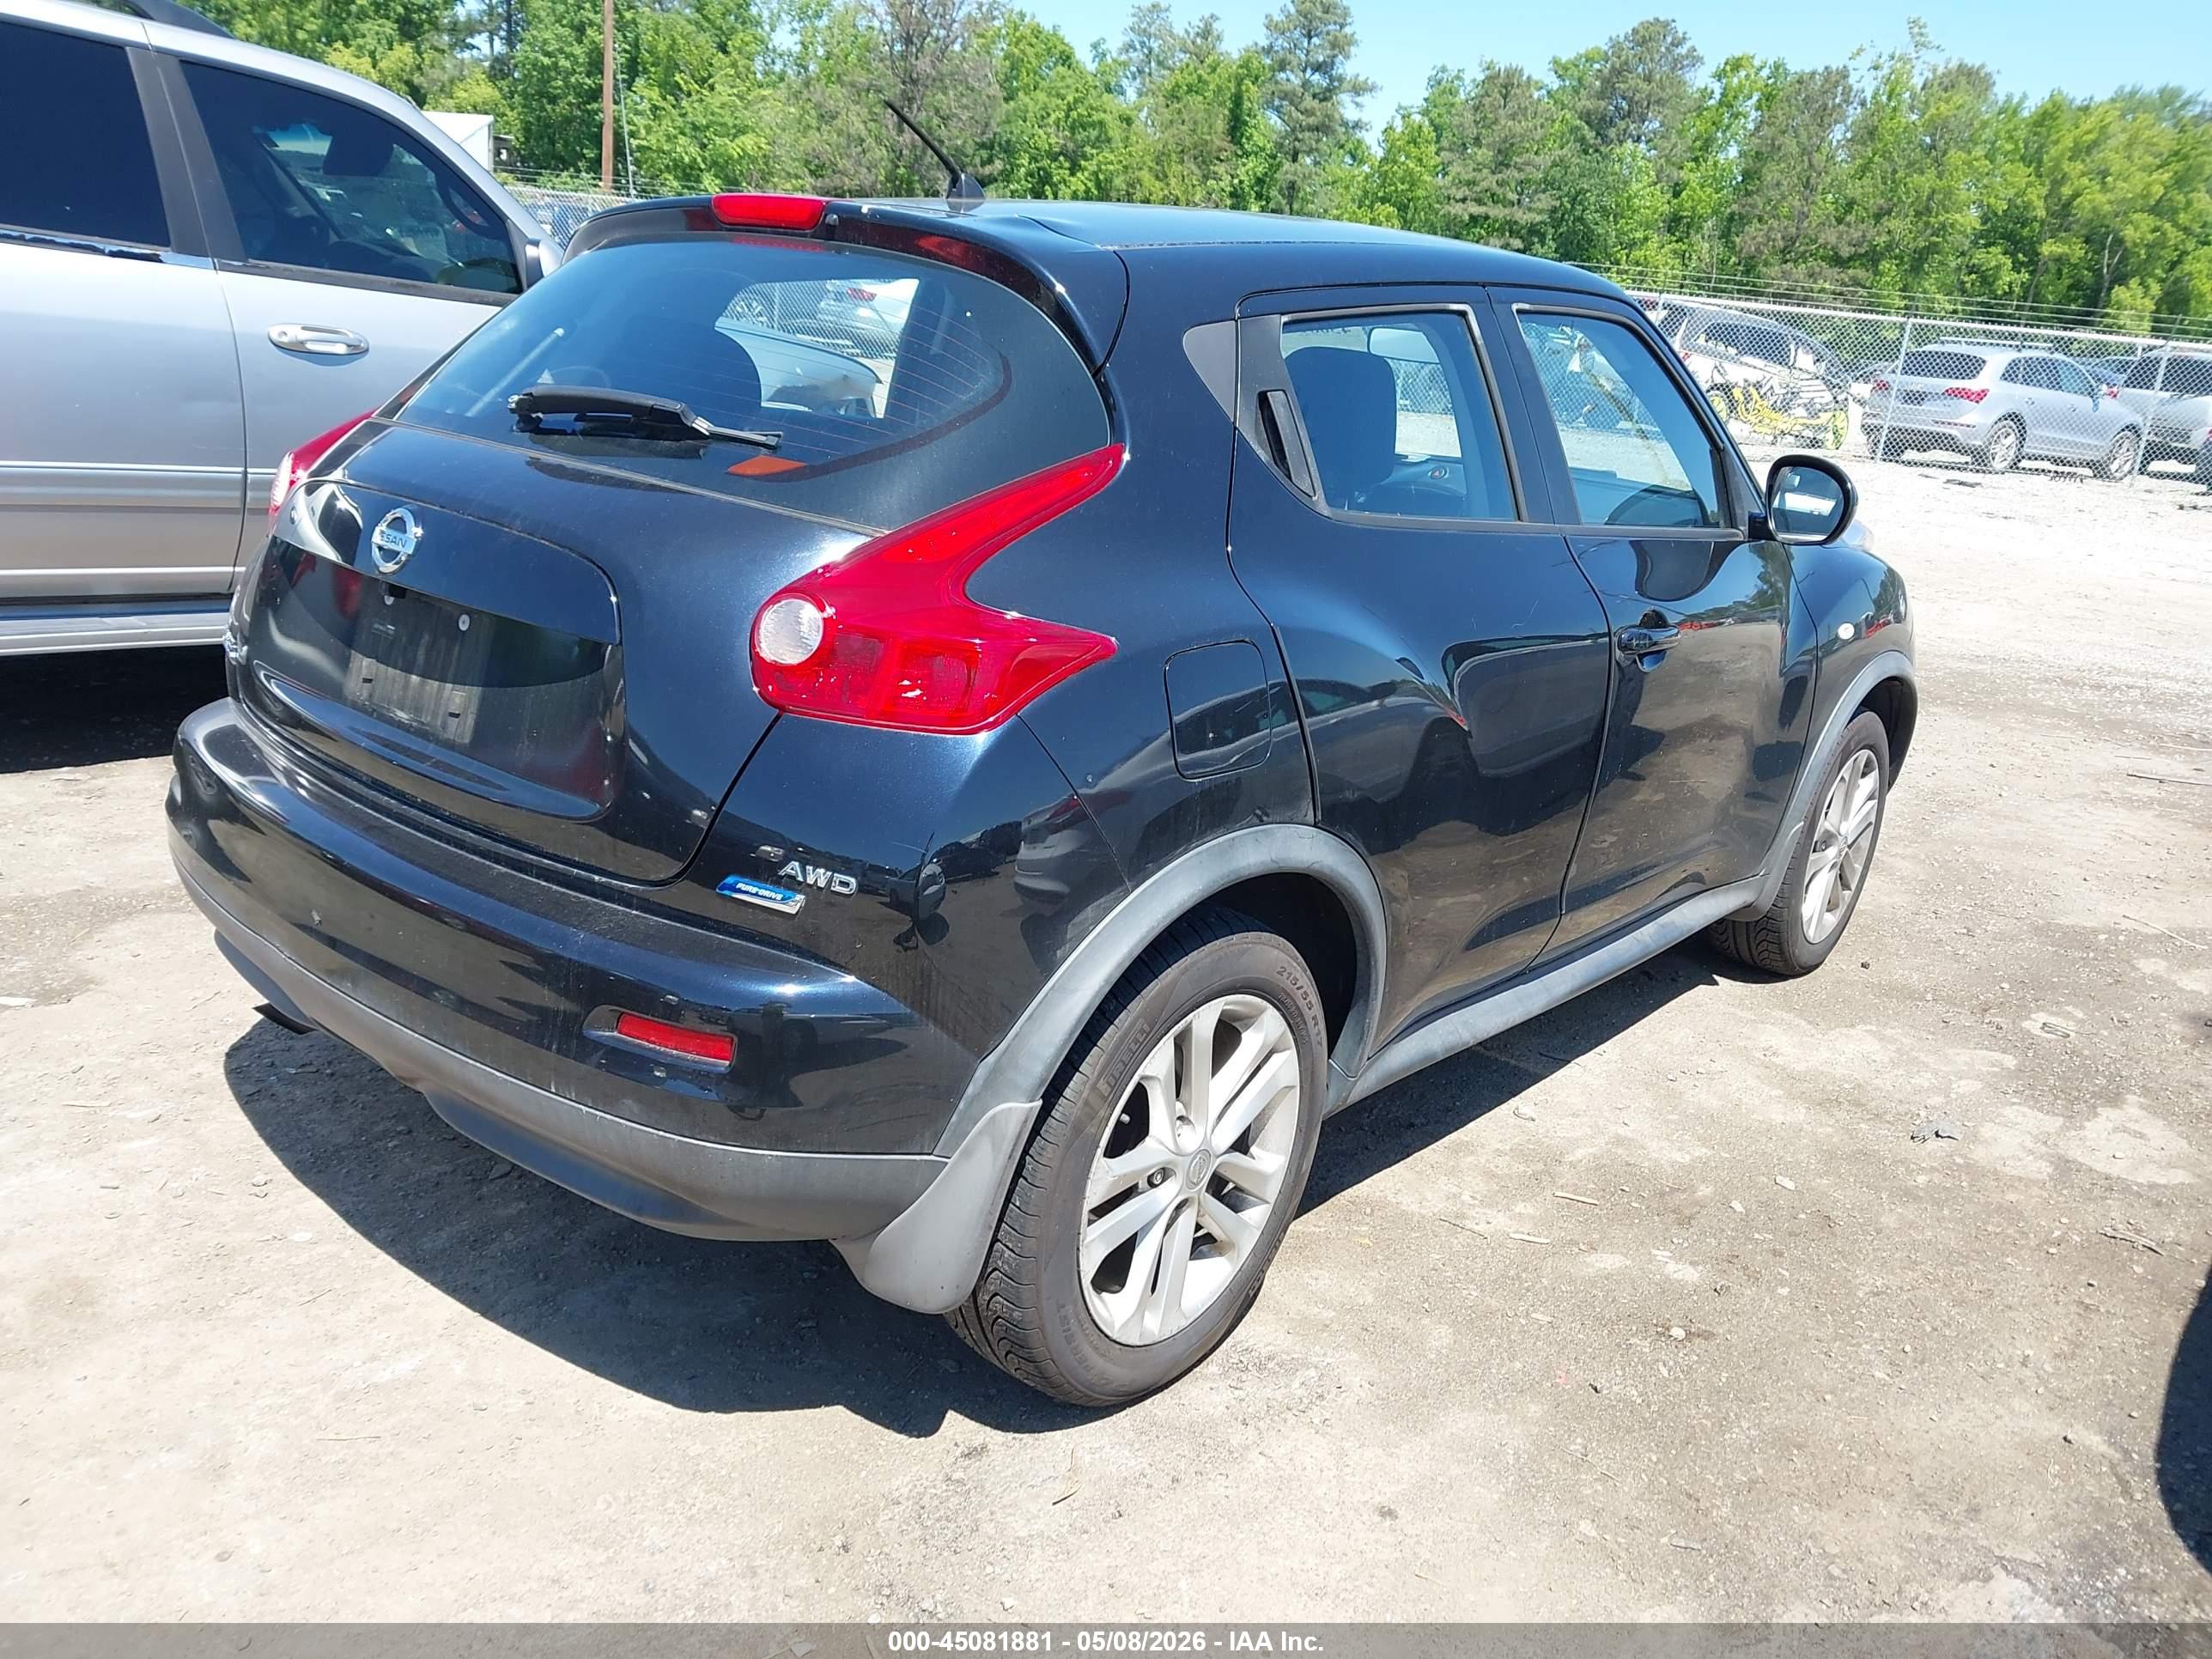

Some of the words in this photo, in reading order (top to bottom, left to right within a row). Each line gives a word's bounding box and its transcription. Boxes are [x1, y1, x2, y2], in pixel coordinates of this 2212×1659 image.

[778, 860, 859, 896] AWD
[1276, 965, 1315, 1012] 215/55
[1311, 1014, 1323, 1048] R17
[1097, 1018, 1152, 1096] PIRELLI
